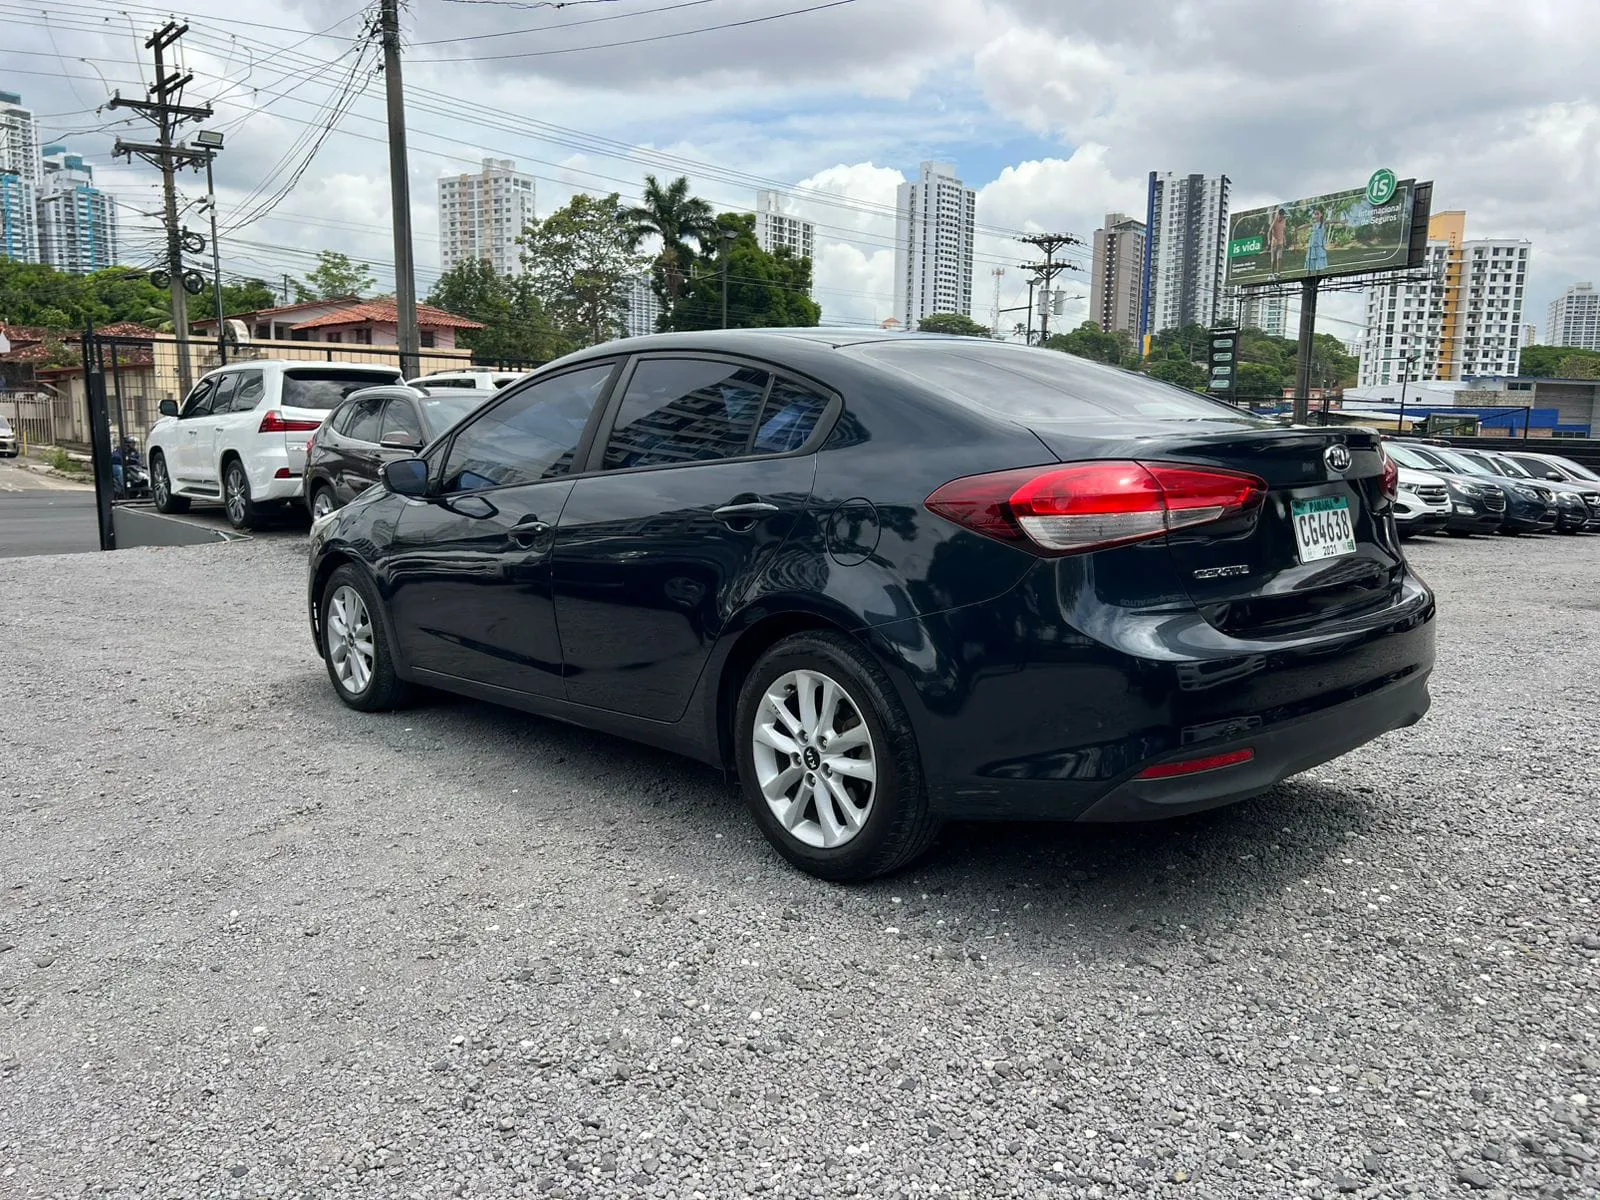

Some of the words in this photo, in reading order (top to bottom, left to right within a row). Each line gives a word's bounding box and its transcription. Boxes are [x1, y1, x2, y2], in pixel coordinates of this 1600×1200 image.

[1372, 174, 1389, 197] is
[1370, 214, 1397, 225] Seguros
[1232, 243, 1240, 254] is
[1242, 239, 1261, 252] vida
[1298, 510, 1350, 547] CG4638
[1322, 544, 1338, 556] 2021
[805, 748, 817, 768] KIA
